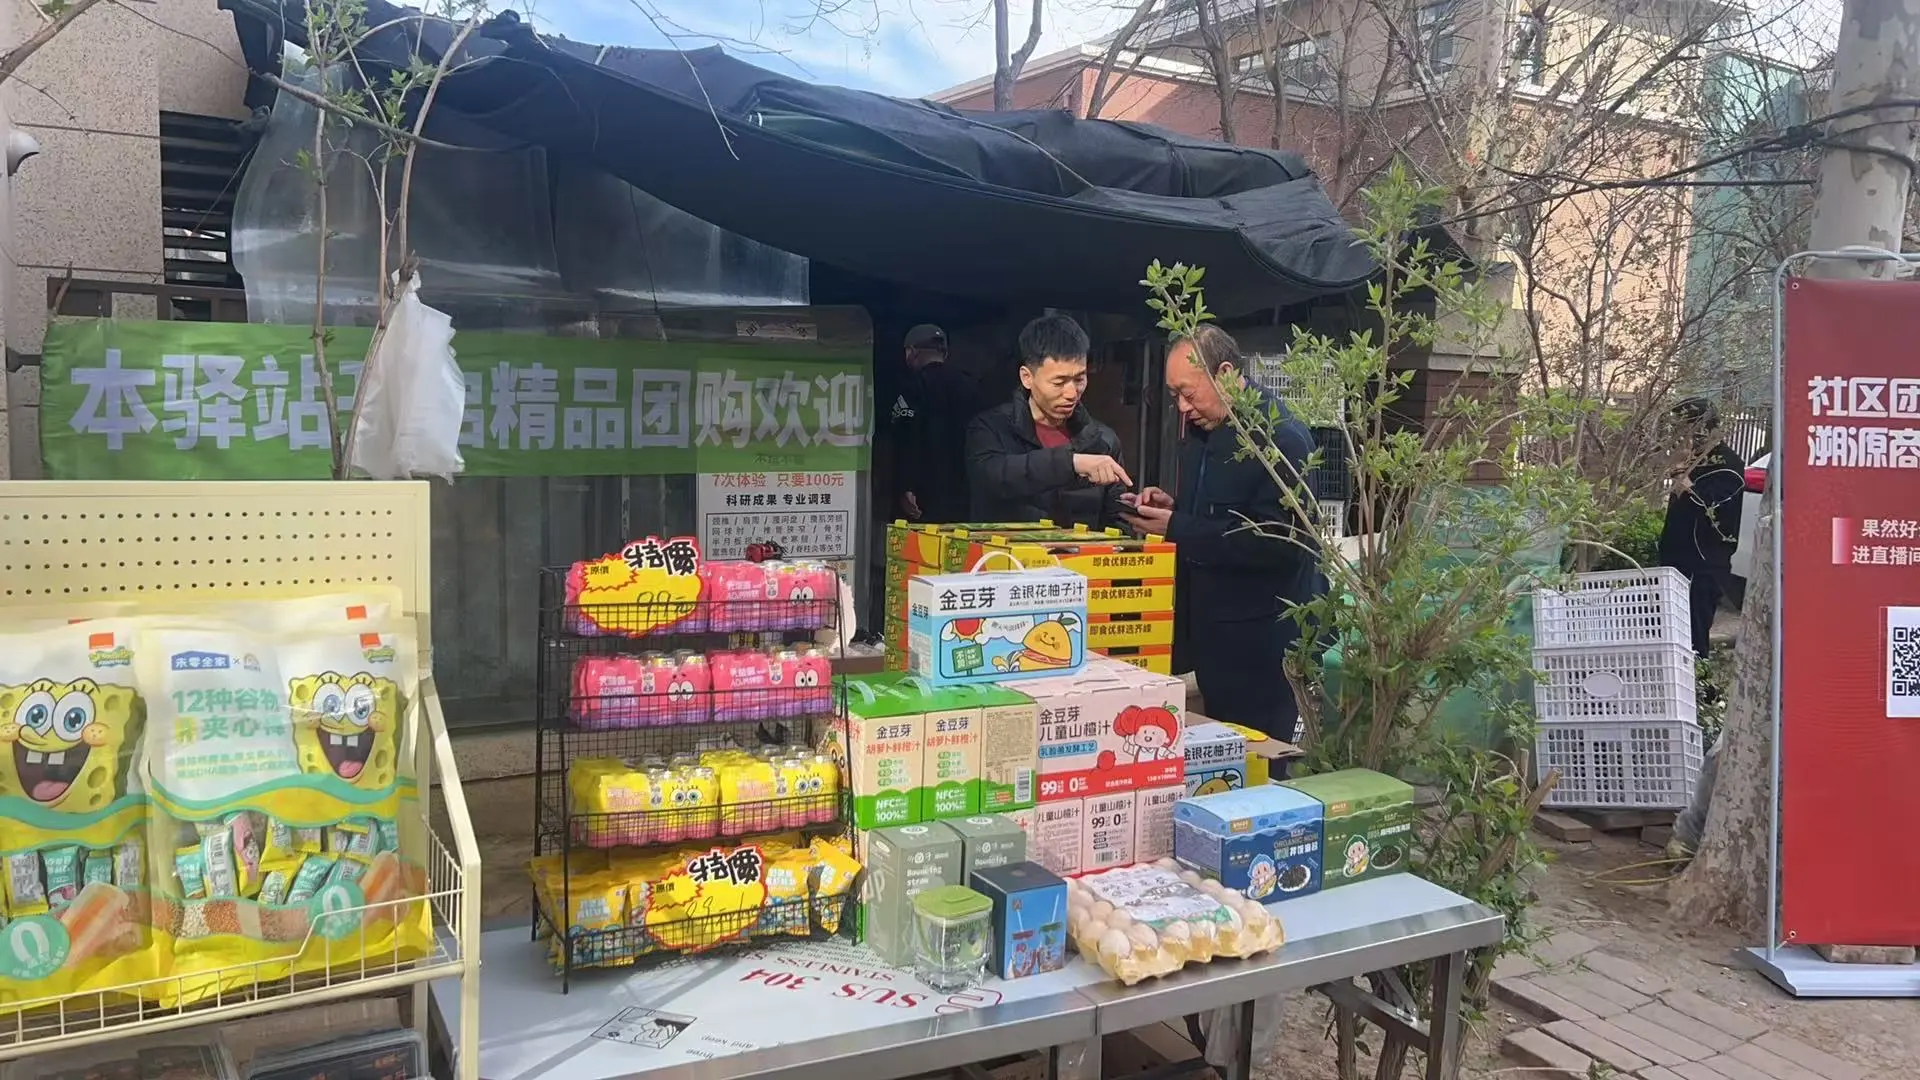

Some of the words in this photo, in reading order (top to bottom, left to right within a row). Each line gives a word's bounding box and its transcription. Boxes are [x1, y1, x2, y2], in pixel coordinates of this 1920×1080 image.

[69, 348, 874, 451] 本驿站精品团购欢迎
[712, 472, 767, 488] 7次体验
[777, 473, 844, 487] 只要100元
[726, 494, 777, 507] 科研成果
[783, 493, 832, 505] 专业调理
[1862, 519, 1920, 538] 果然好
[940, 587, 996, 611] 金豆芽
[1009, 581, 1085, 600] 金银花柚子汁
[936, 716, 970, 732] 金豆芽
[1040, 706, 1081, 725] 金豆芽
[876, 724, 912, 739] 金豆芽
[773, 955, 896, 982] STAINLESS
[739, 968, 820, 989] 304
[833, 982, 928, 1008] SUS
